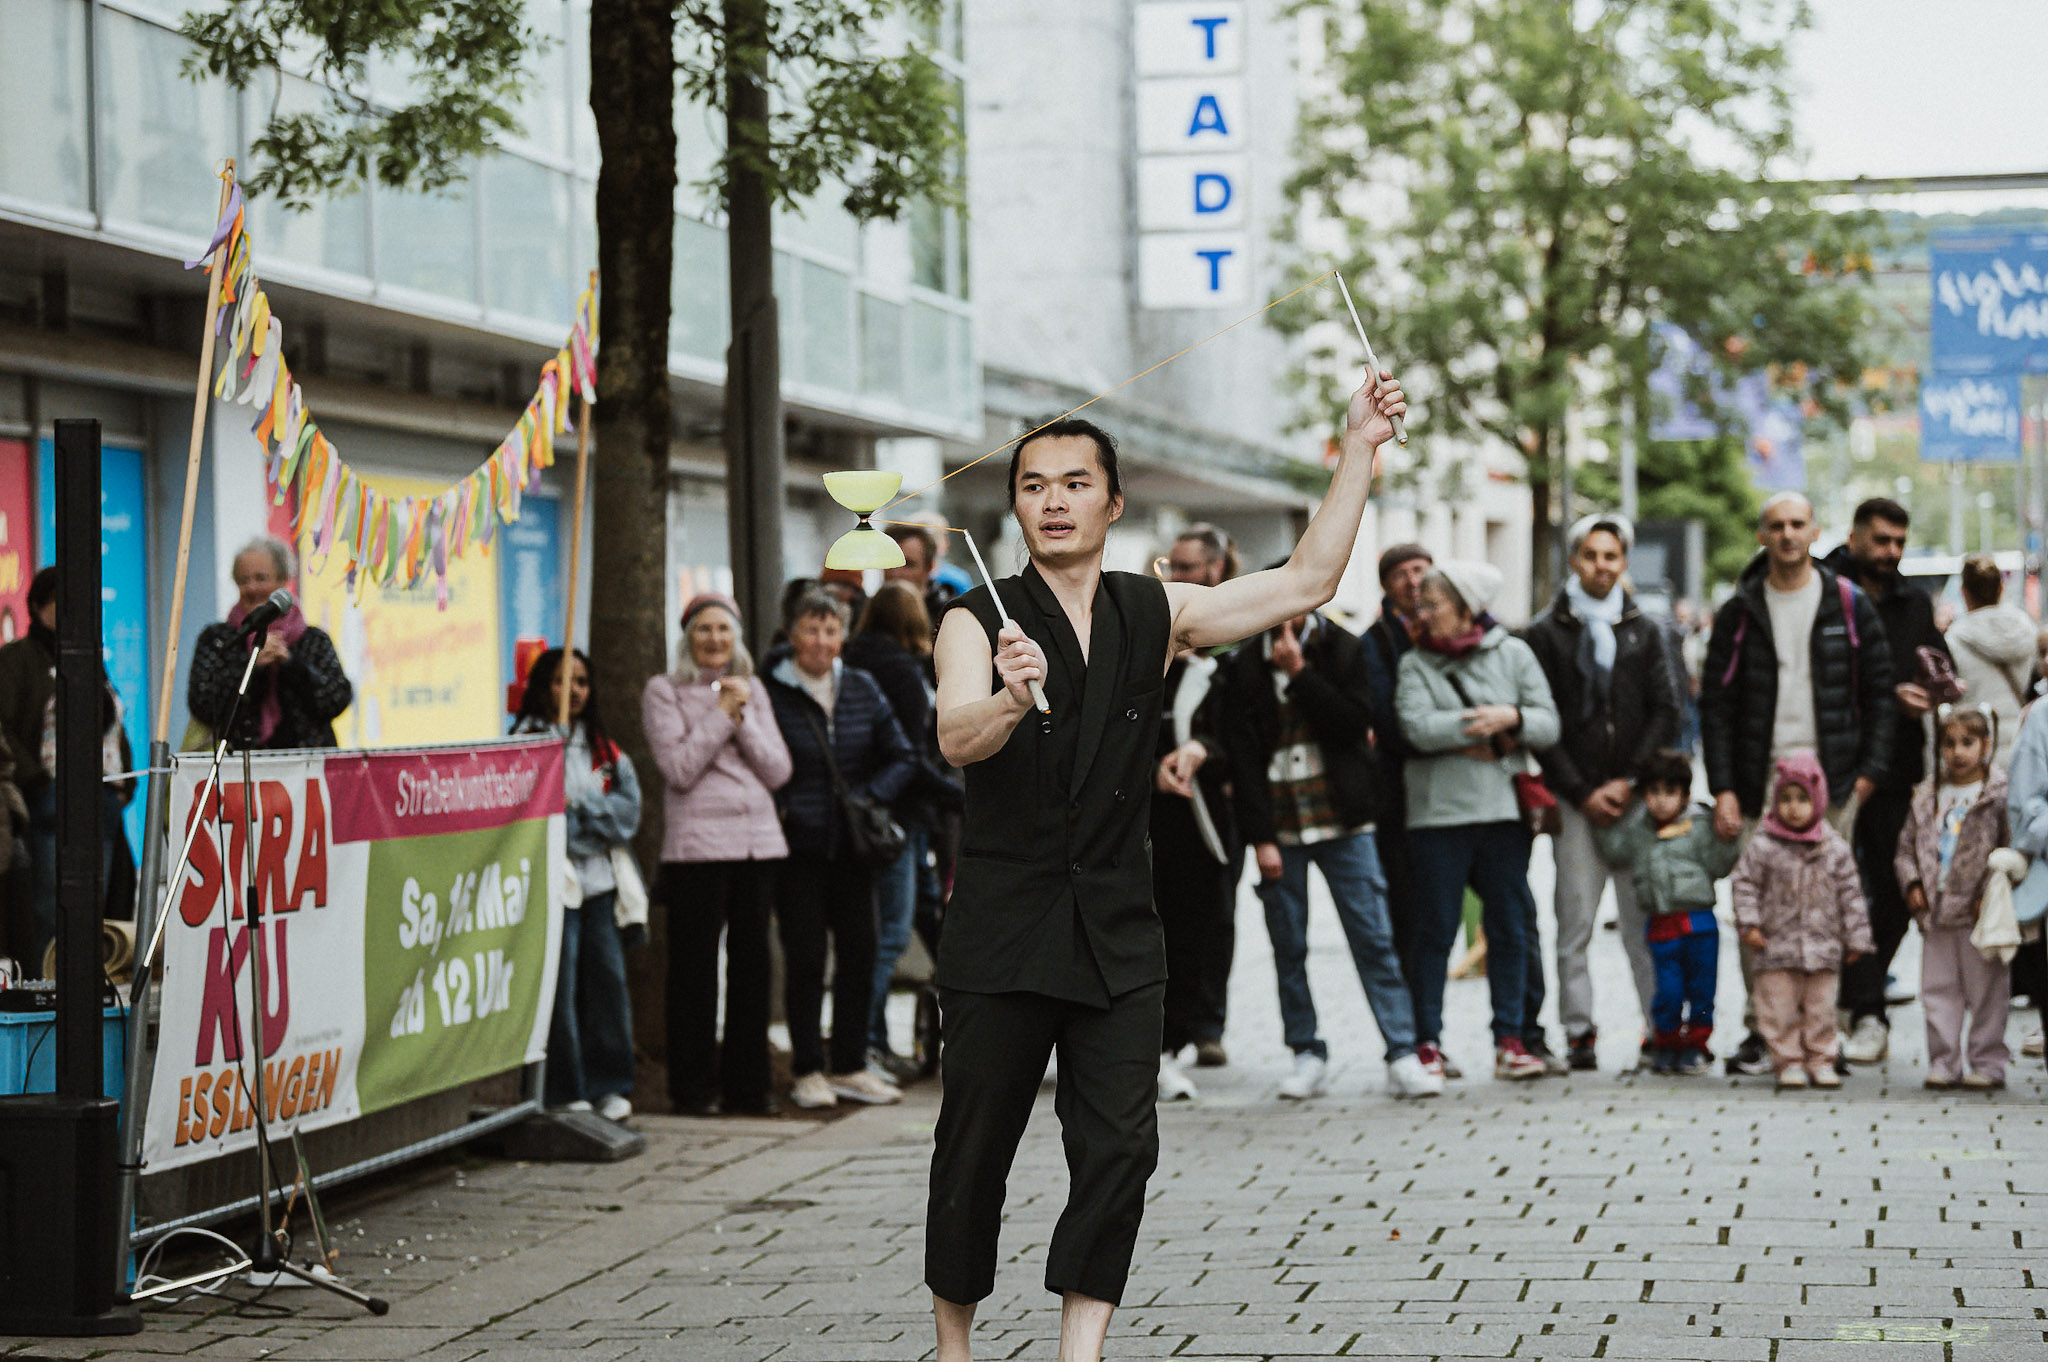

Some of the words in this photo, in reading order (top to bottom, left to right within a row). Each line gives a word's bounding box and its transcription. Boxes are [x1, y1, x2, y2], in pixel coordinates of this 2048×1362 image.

[179, 778, 328, 928] STRA
[399, 876, 443, 957] Sa,
[475, 857, 531, 931] Mai
[195, 918, 290, 1068] KU
[432, 957, 472, 1028] 12
